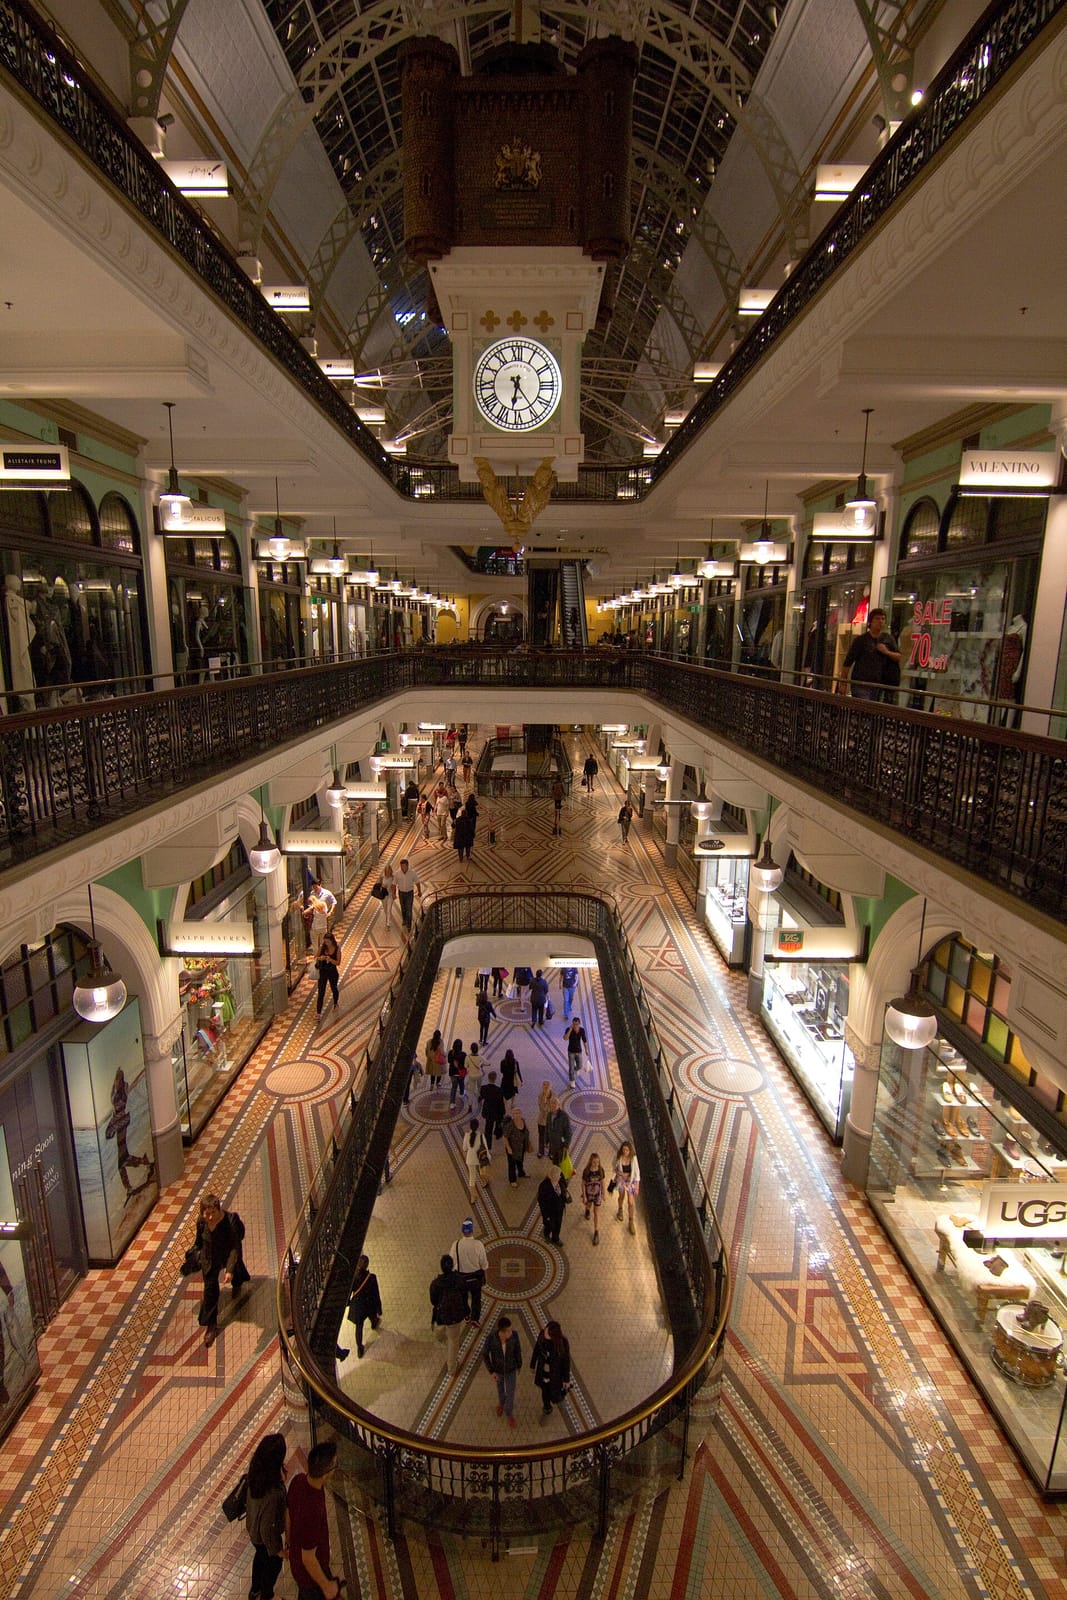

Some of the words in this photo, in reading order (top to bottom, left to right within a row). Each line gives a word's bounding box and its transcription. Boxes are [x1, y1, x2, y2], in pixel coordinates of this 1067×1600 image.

[494, 351, 508, 365] XI
[511, 346, 523, 361] XII
[485, 366, 498, 377] X
[536, 363, 550, 376] II
[480, 380, 494, 390] IX
[539, 380, 554, 390] III
[497, 404, 508, 423] VII
[513, 410, 523, 424] VI
[970, 460, 1040, 474] VALENTINO
[912, 600, 953, 625] SALE
[784, 933, 800, 943] TAG
[34, 1133, 55, 1158] Soon
[1000, 1199, 1067, 1228] UGG
